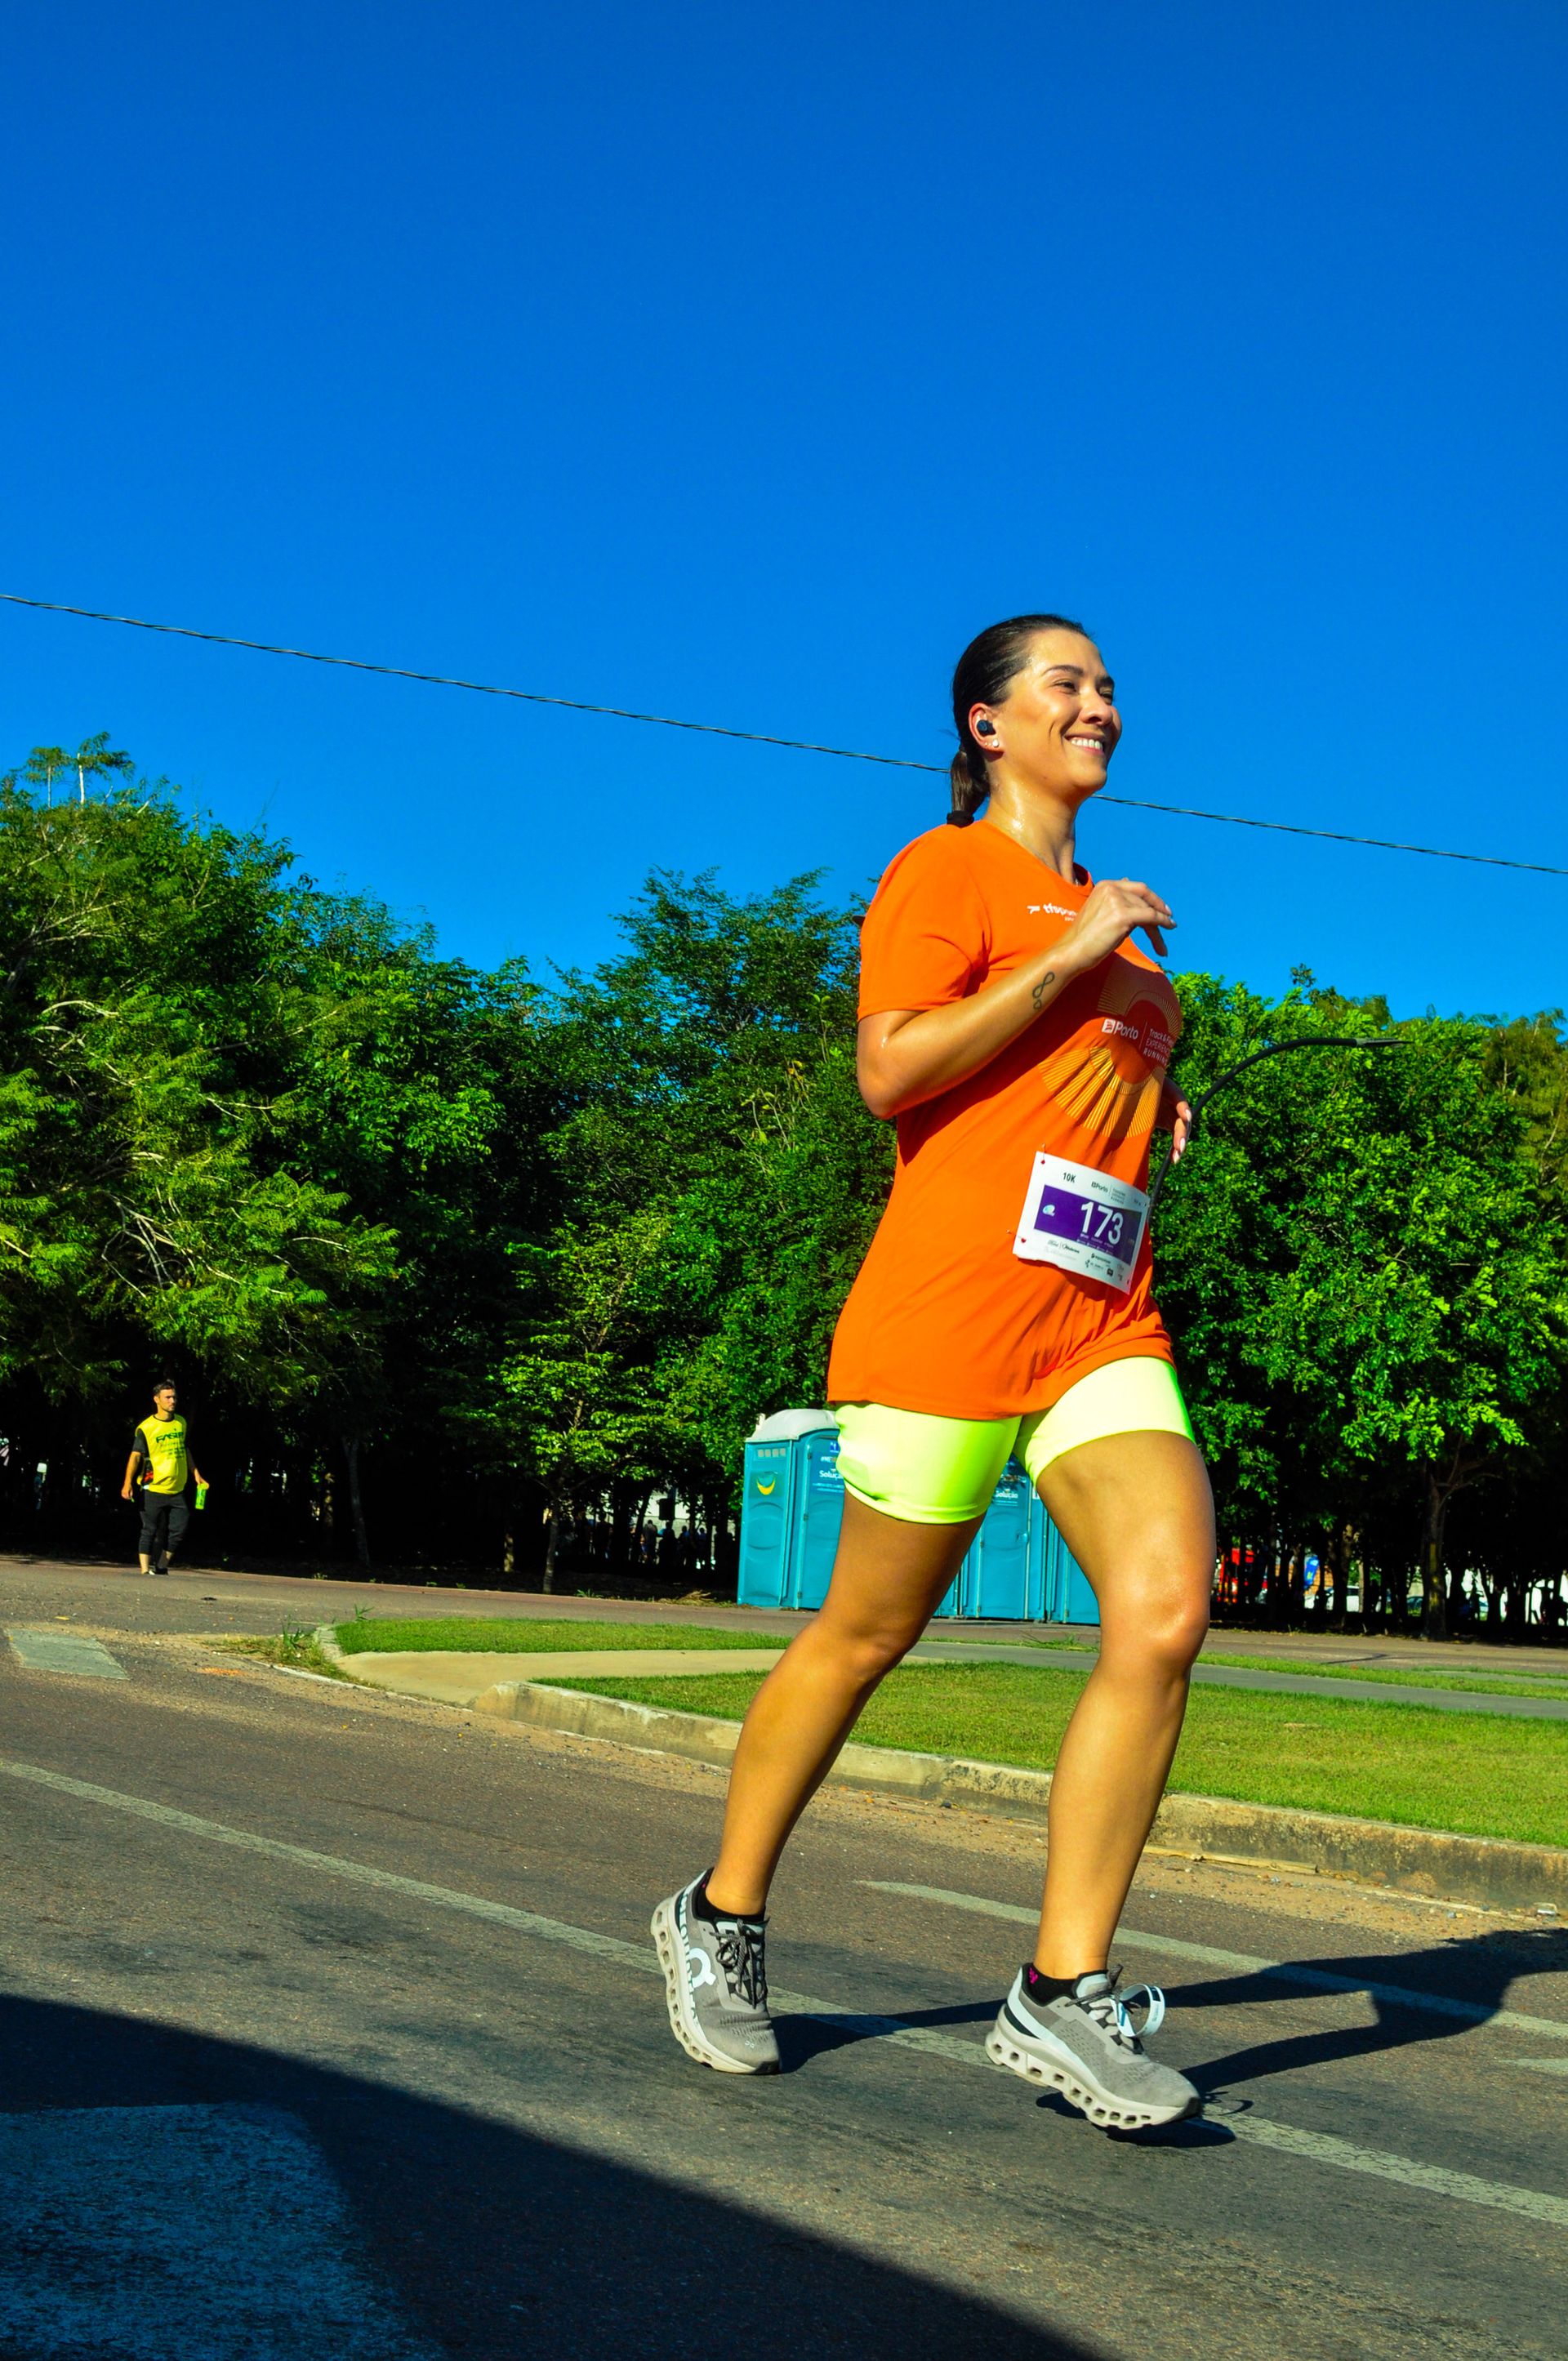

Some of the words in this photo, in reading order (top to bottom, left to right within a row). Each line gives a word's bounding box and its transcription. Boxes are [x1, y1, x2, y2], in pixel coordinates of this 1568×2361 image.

[1113, 1021, 1139, 1040] Porto
[1062, 1172, 1076, 1183] 10K
[1080, 1201, 1124, 1245] 173
